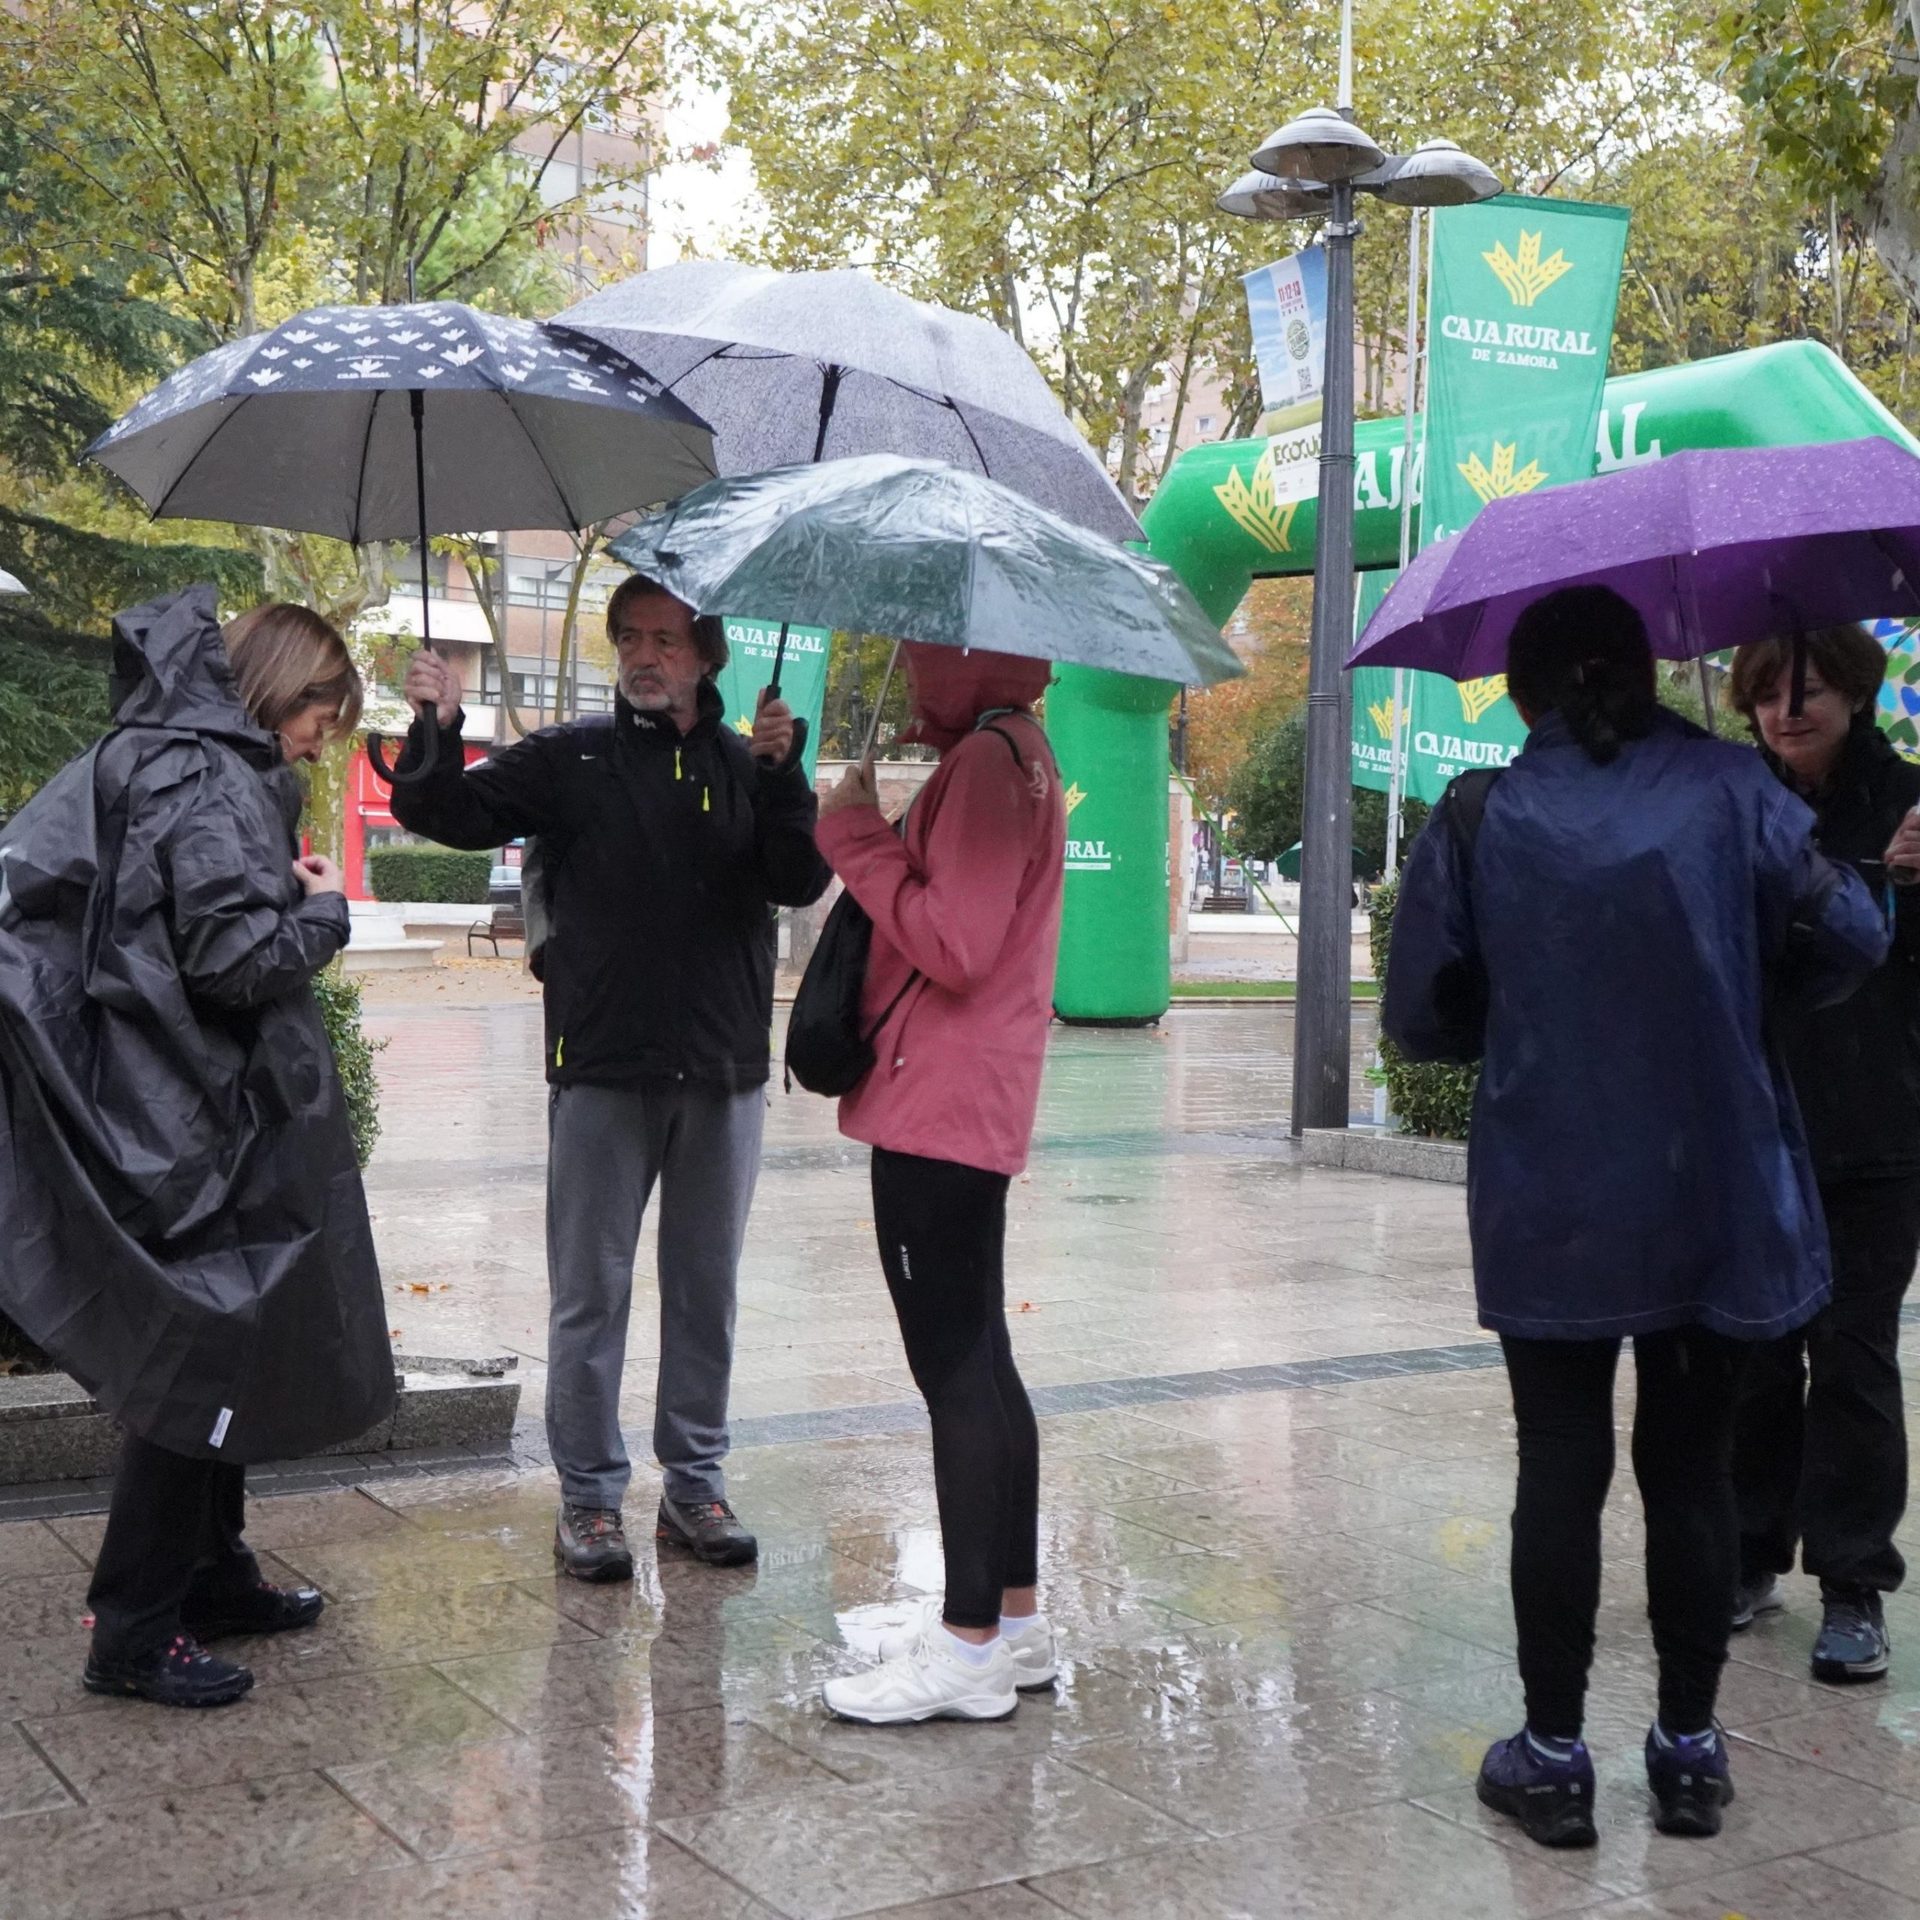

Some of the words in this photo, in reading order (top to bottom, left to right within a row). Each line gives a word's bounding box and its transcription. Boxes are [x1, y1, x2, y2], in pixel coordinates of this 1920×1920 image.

[1441, 315, 1503, 346] CAJA
[1504, 323, 1598, 356] RURAL
[1472, 348, 1491, 362] DE
[1496, 351, 1559, 370] ZAMORA
[726, 625, 765, 645] CAJA
[744, 646, 758, 656] DE
[760, 648, 800, 662] ZAORA
[1463, 741, 1521, 767] RURA
[1358, 760, 1370, 770] DE
[1436, 763, 1455, 776] DE
